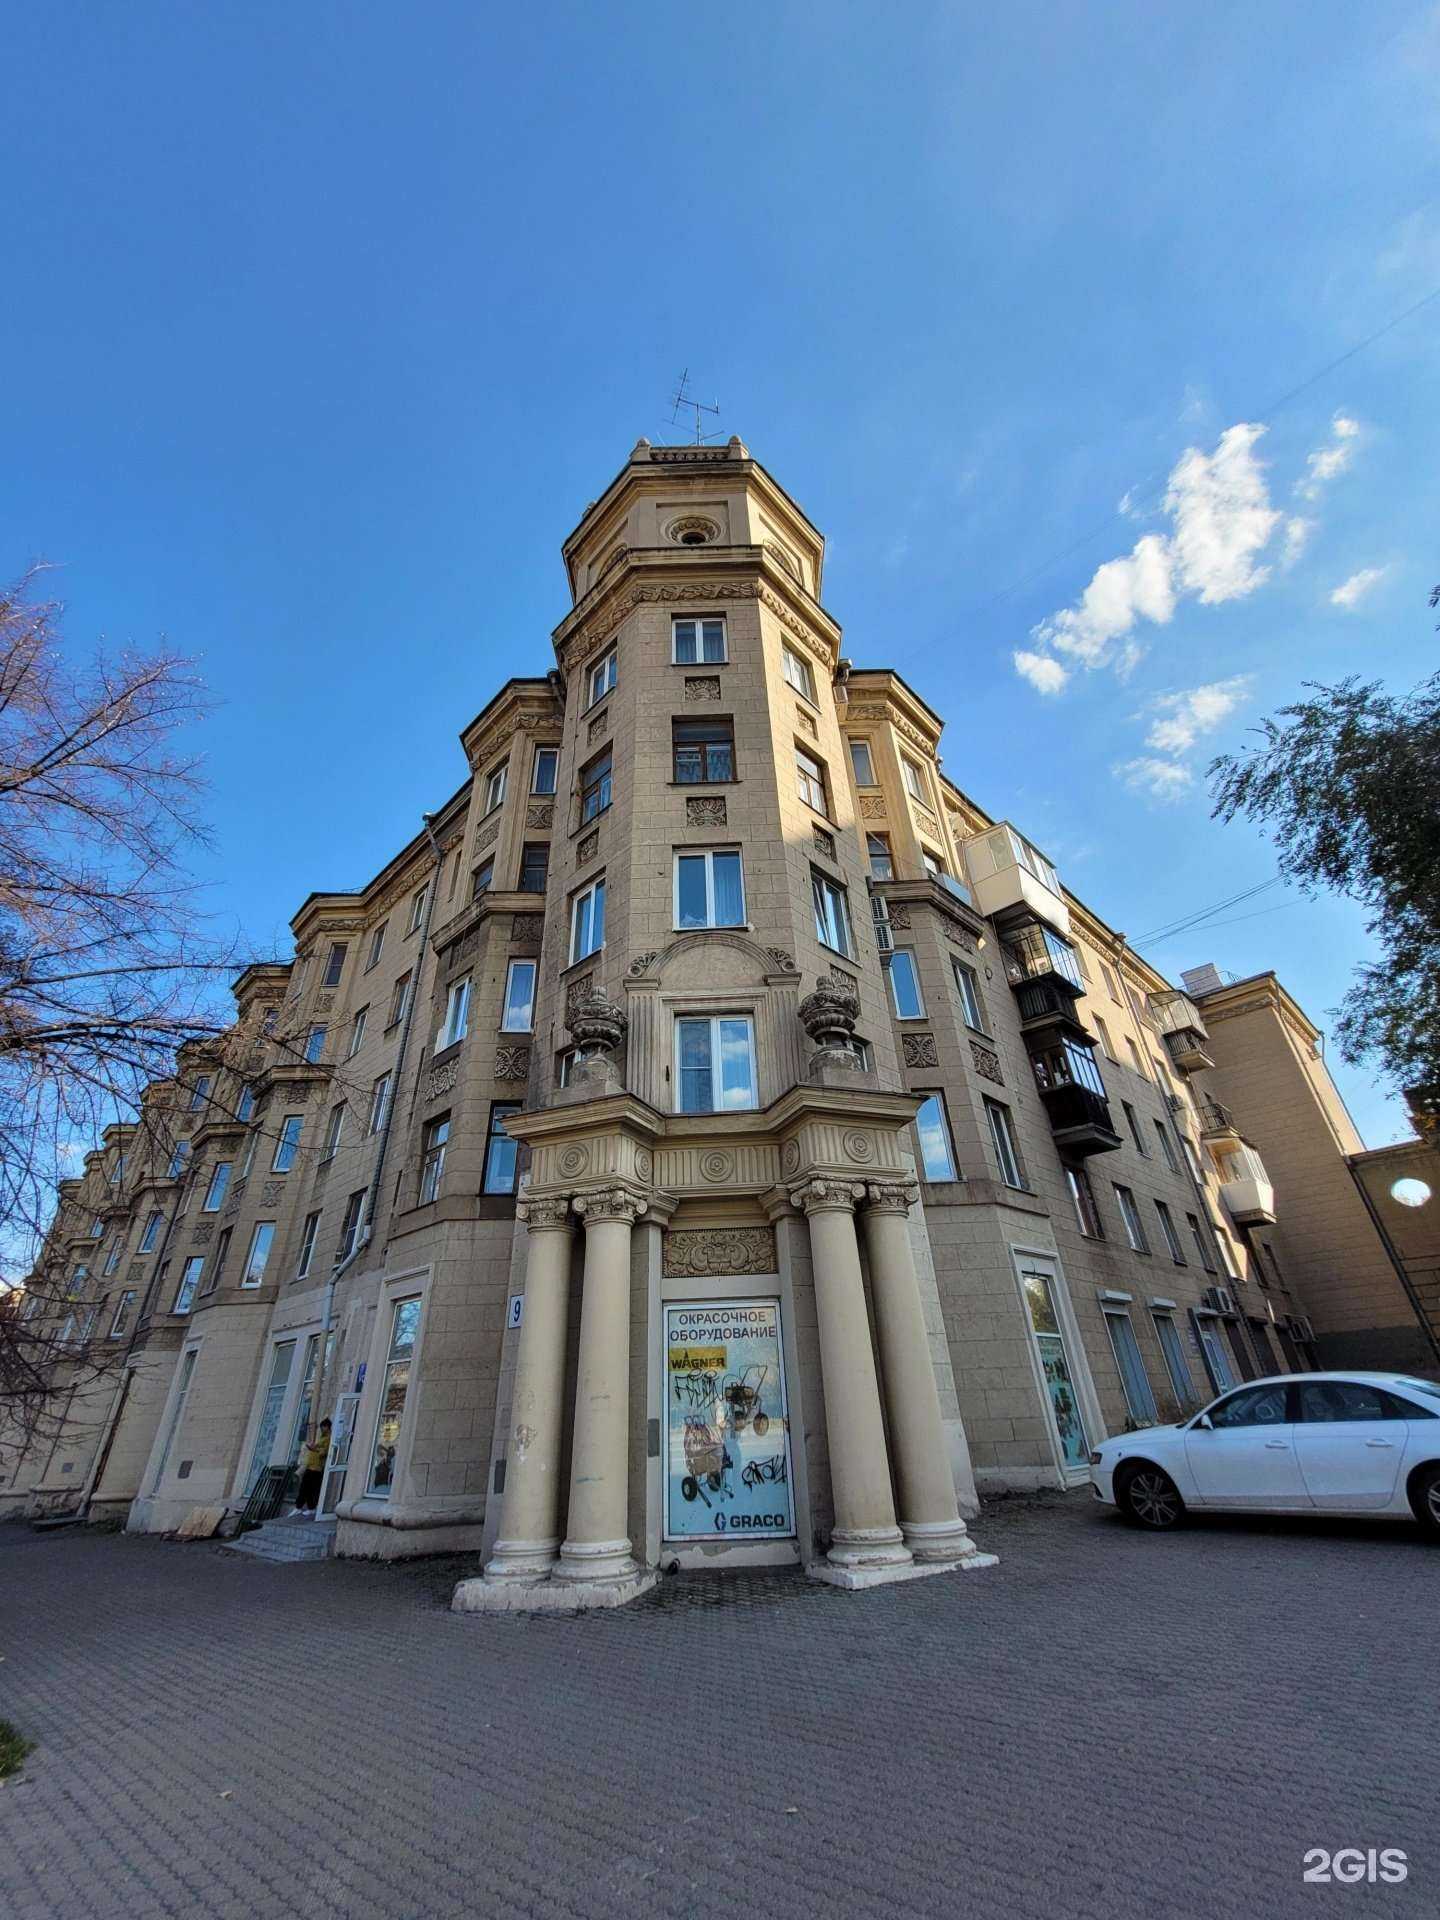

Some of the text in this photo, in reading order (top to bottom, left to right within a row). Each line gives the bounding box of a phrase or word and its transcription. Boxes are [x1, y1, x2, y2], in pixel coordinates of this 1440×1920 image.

[513, 1300, 521, 1322] 9
[678, 1311, 766, 1325] ОКРАСОЧНОЕ
[670, 1327, 776, 1341] ОБОРУДОВАНИЕ
[671, 1354, 725, 1369] WAGNER
[729, 1514, 785, 1528] GRACO
